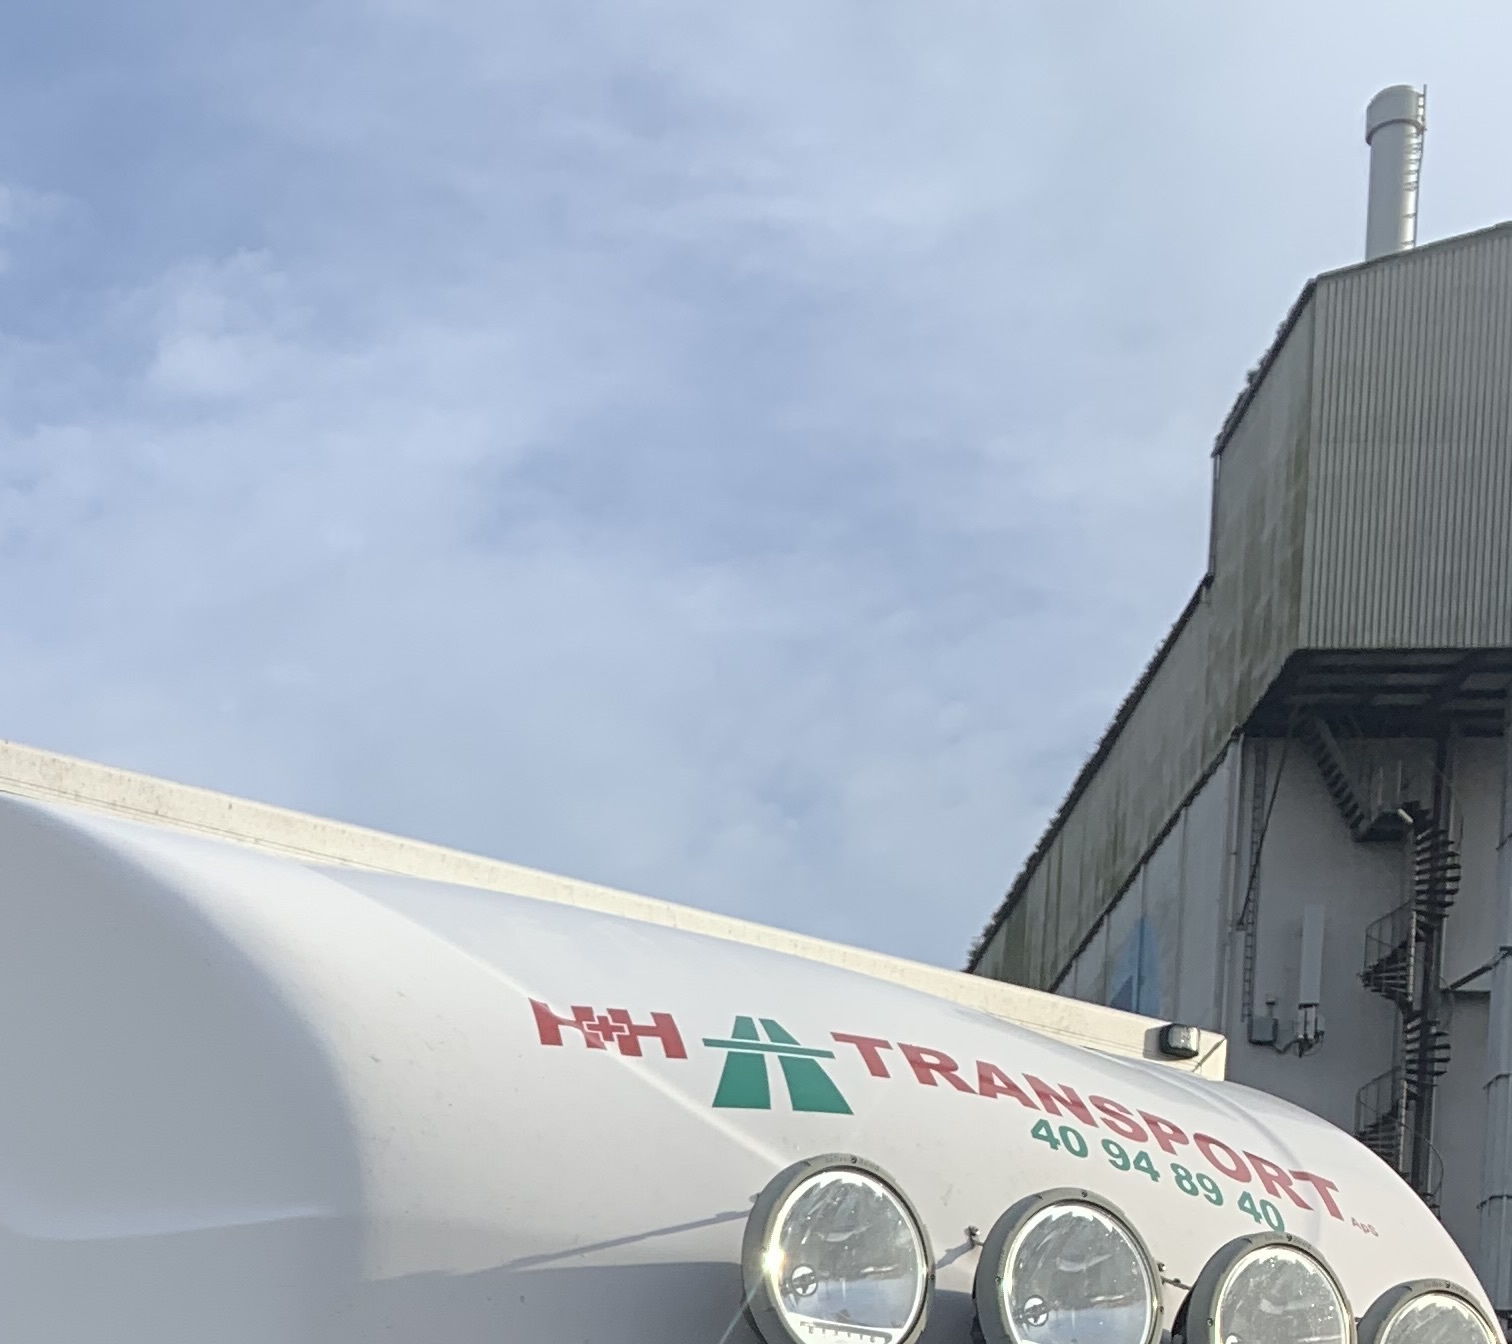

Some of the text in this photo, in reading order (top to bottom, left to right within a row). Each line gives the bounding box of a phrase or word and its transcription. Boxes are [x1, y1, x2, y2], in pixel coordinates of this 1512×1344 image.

[831, 1031, 1345, 1221] TRANSPORT
[1351, 1217, 1379, 1237] ApS
[1030, 1119, 1286, 1233] 40 94 89 40
